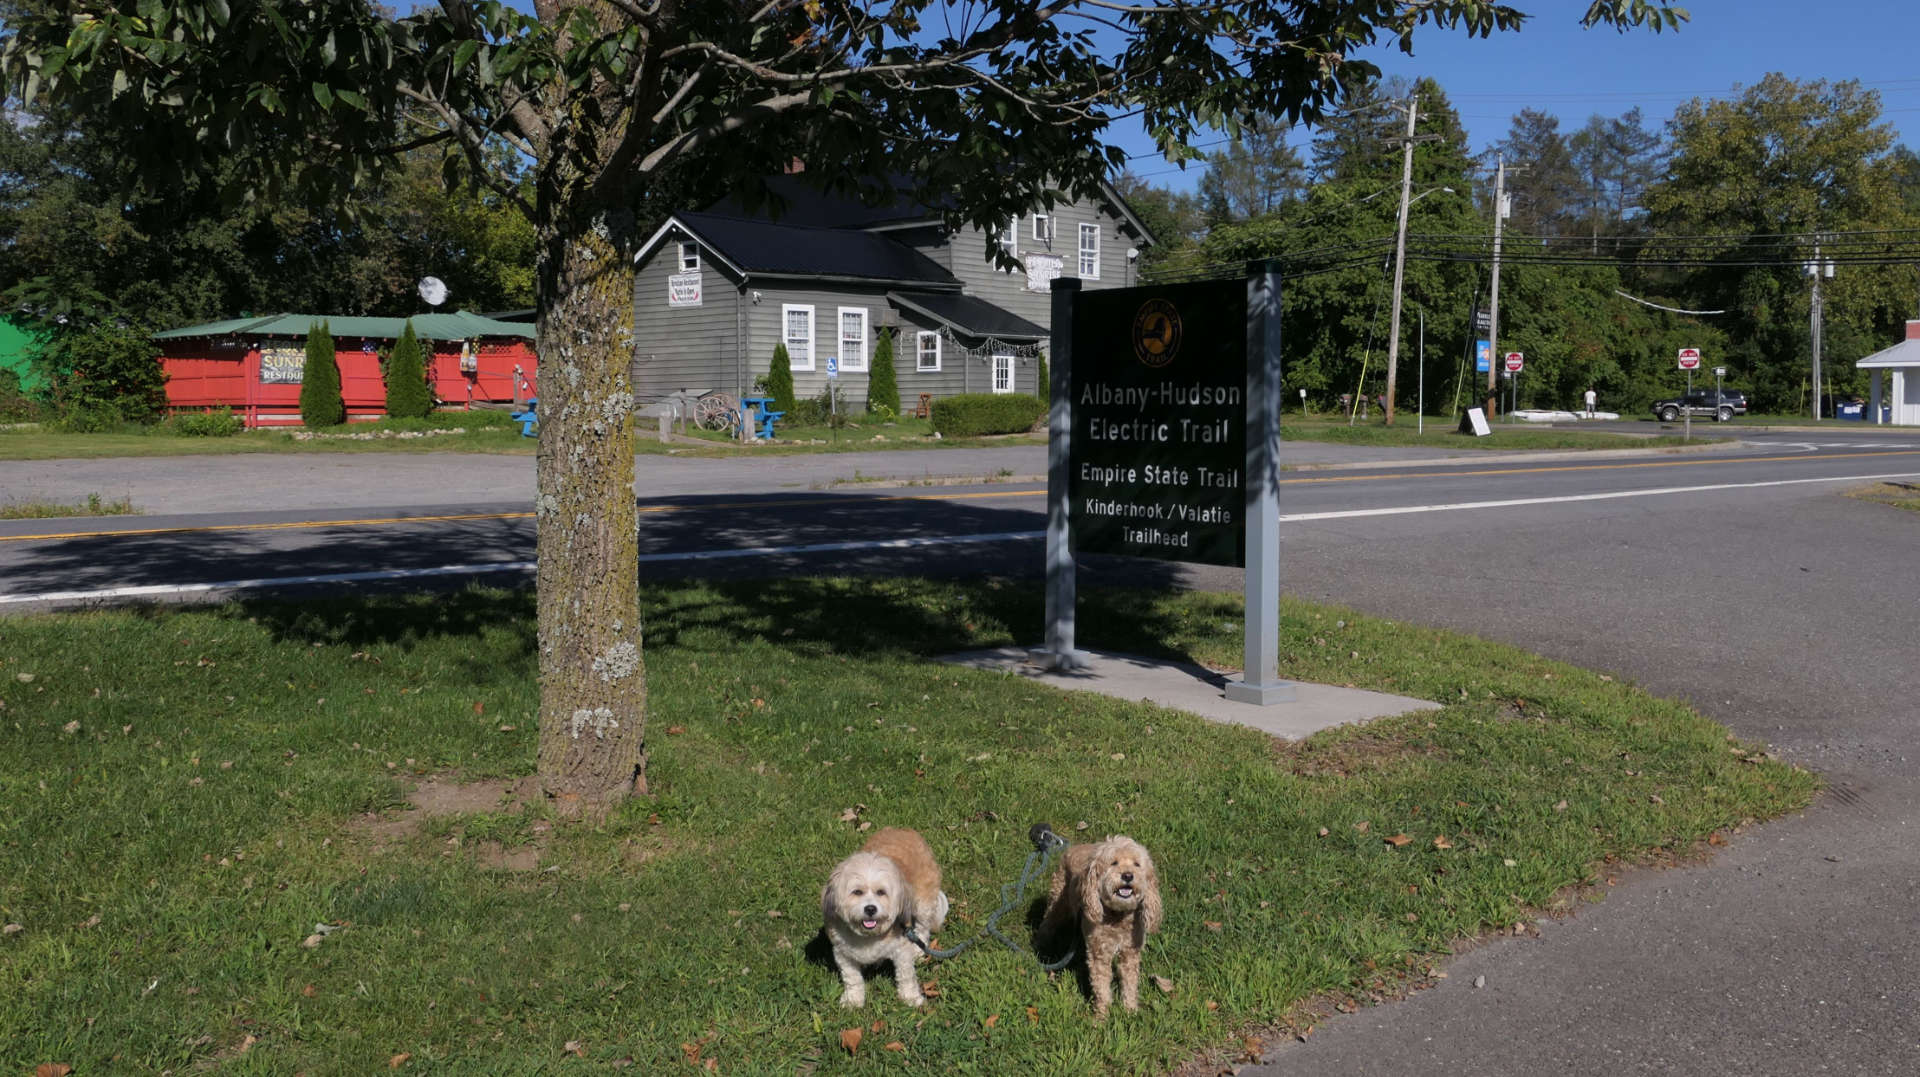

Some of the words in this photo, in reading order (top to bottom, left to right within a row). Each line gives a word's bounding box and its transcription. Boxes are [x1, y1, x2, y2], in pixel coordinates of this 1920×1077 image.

[1080, 382, 1240, 412] Albany-Hudson
[1090, 418, 1168, 442] Electric
[1180, 419, 1228, 443] Trail
[1081, 463, 1136, 487] Empire
[1144, 465, 1188, 486] State
[1198, 467, 1238, 489] Trail
[1122, 525, 1188, 547] Trailhead
